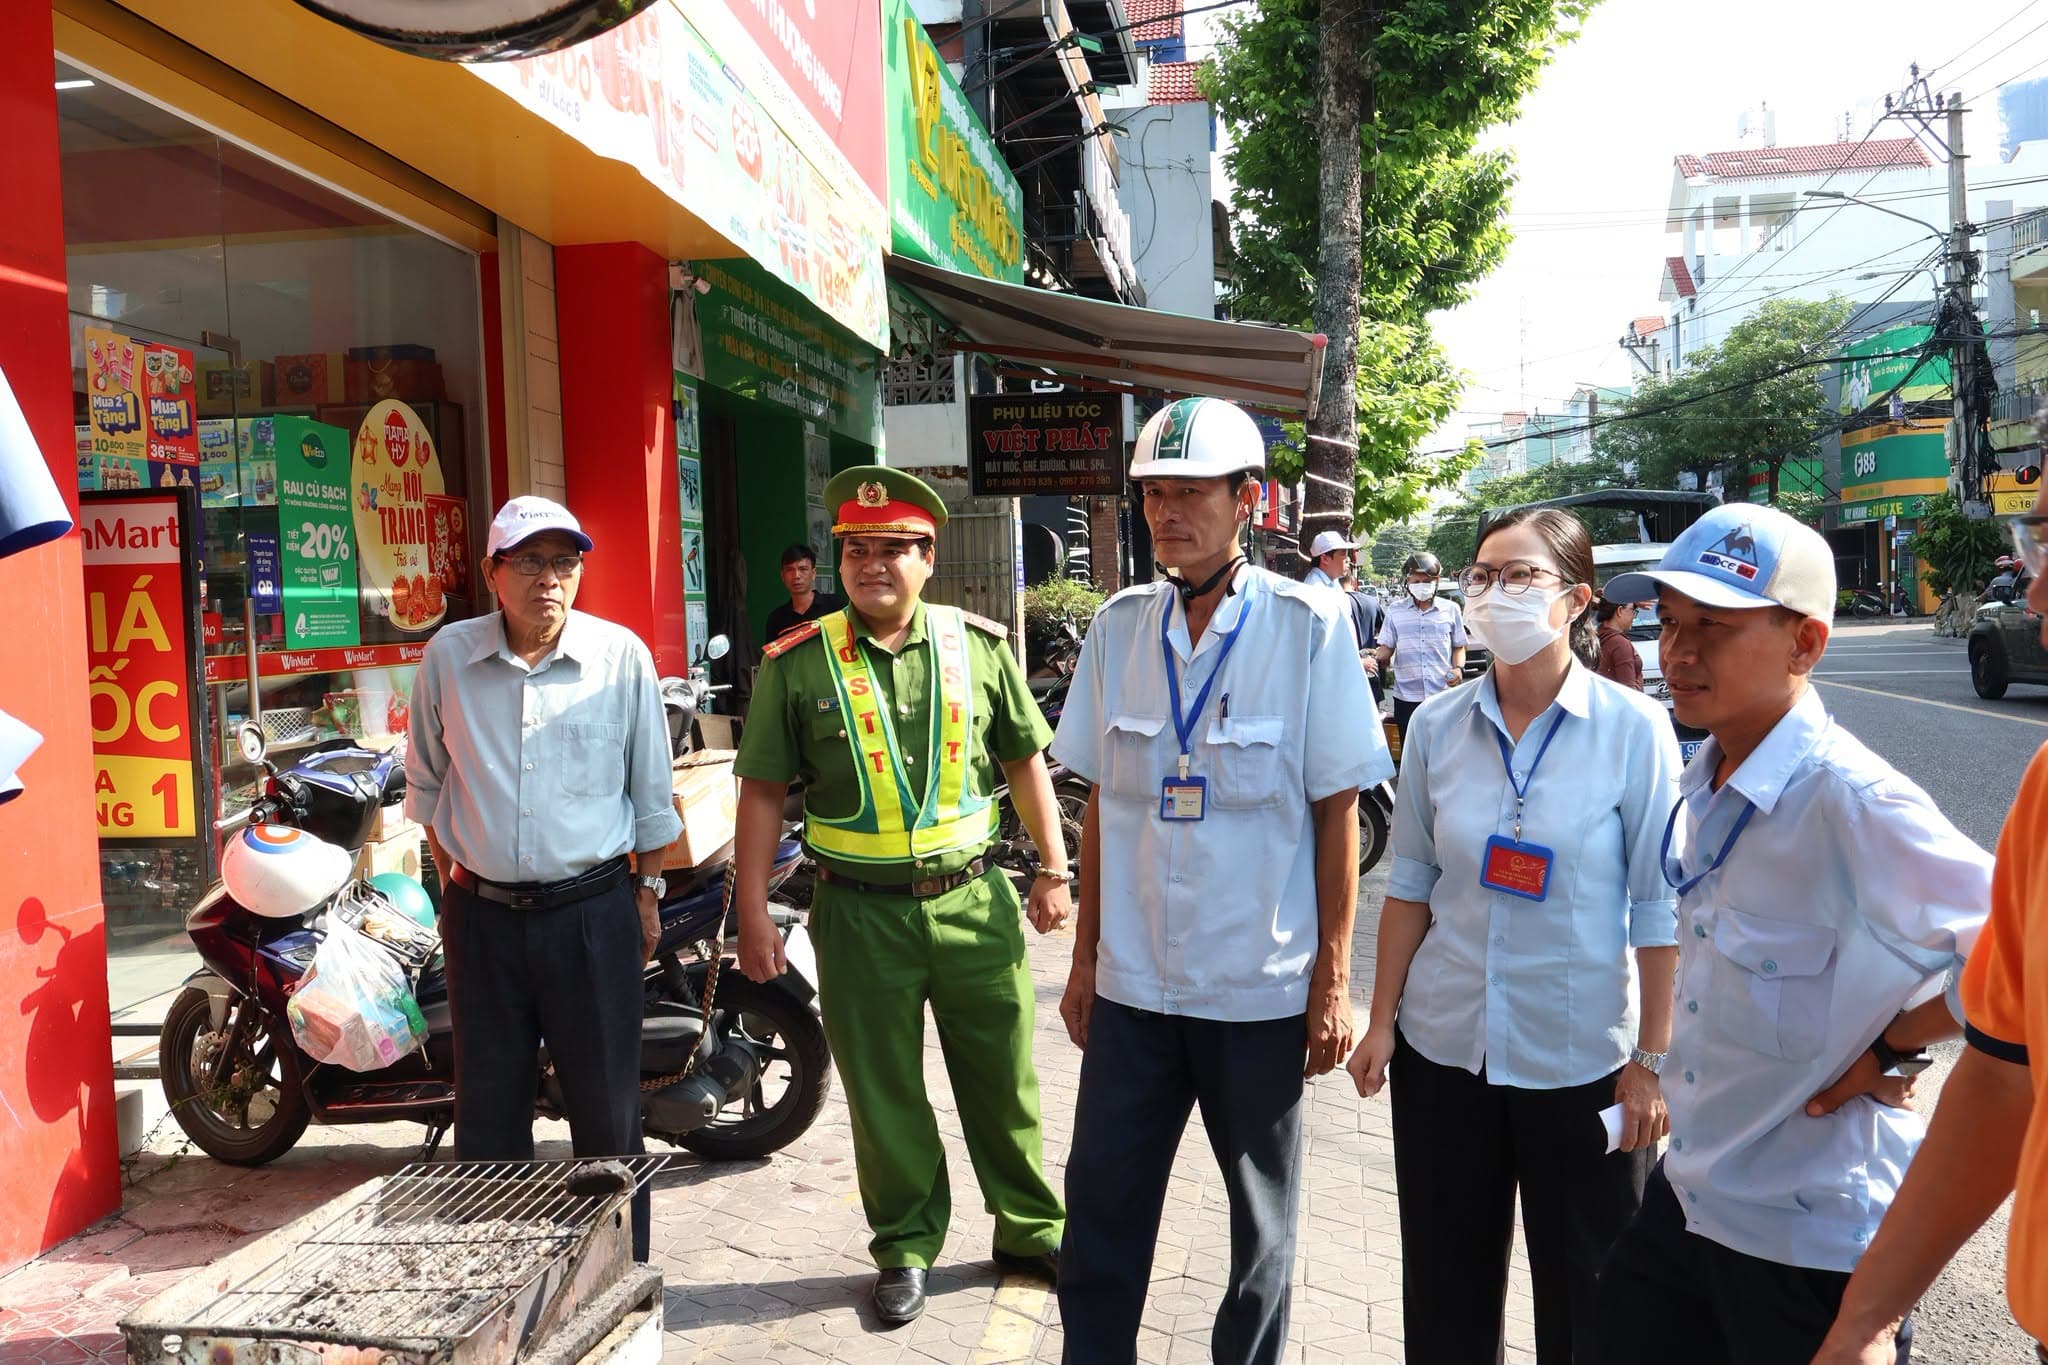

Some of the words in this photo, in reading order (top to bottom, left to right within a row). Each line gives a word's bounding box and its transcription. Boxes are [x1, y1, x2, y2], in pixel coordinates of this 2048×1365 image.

[93, 395, 114, 408] Mua
[115, 396, 123, 408] 2
[94, 408, 126, 428] Tặng
[122, 392, 137, 424] 1
[151, 399, 178, 415] Mua
[1030, 402, 1062, 422] LIỆU
[1067, 401, 1101, 418] TÓC
[151, 415, 180, 433] Tặng
[177, 400, 188, 430] 1
[384, 425, 409, 442] MAMA
[983, 423, 1041, 458] VIỆT
[1045, 421, 1112, 451] PHÁT
[151, 444, 165, 458] 36
[391, 442, 406, 460] HY
[1854, 451, 1876, 477] F88
[283, 480, 304, 496] RAU
[321, 485, 347, 503] SẠCH
[1890, 502, 1904, 515] XE
[287, 529, 300, 539] TIẾT
[378, 503, 426, 545] TRĂNG
[286, 541, 300, 553] KIỆM
[301, 522, 349, 560] 20%
[258, 580, 274, 595] QR
[295, 613, 306, 639] 4
[151, 774, 179, 829] 1
